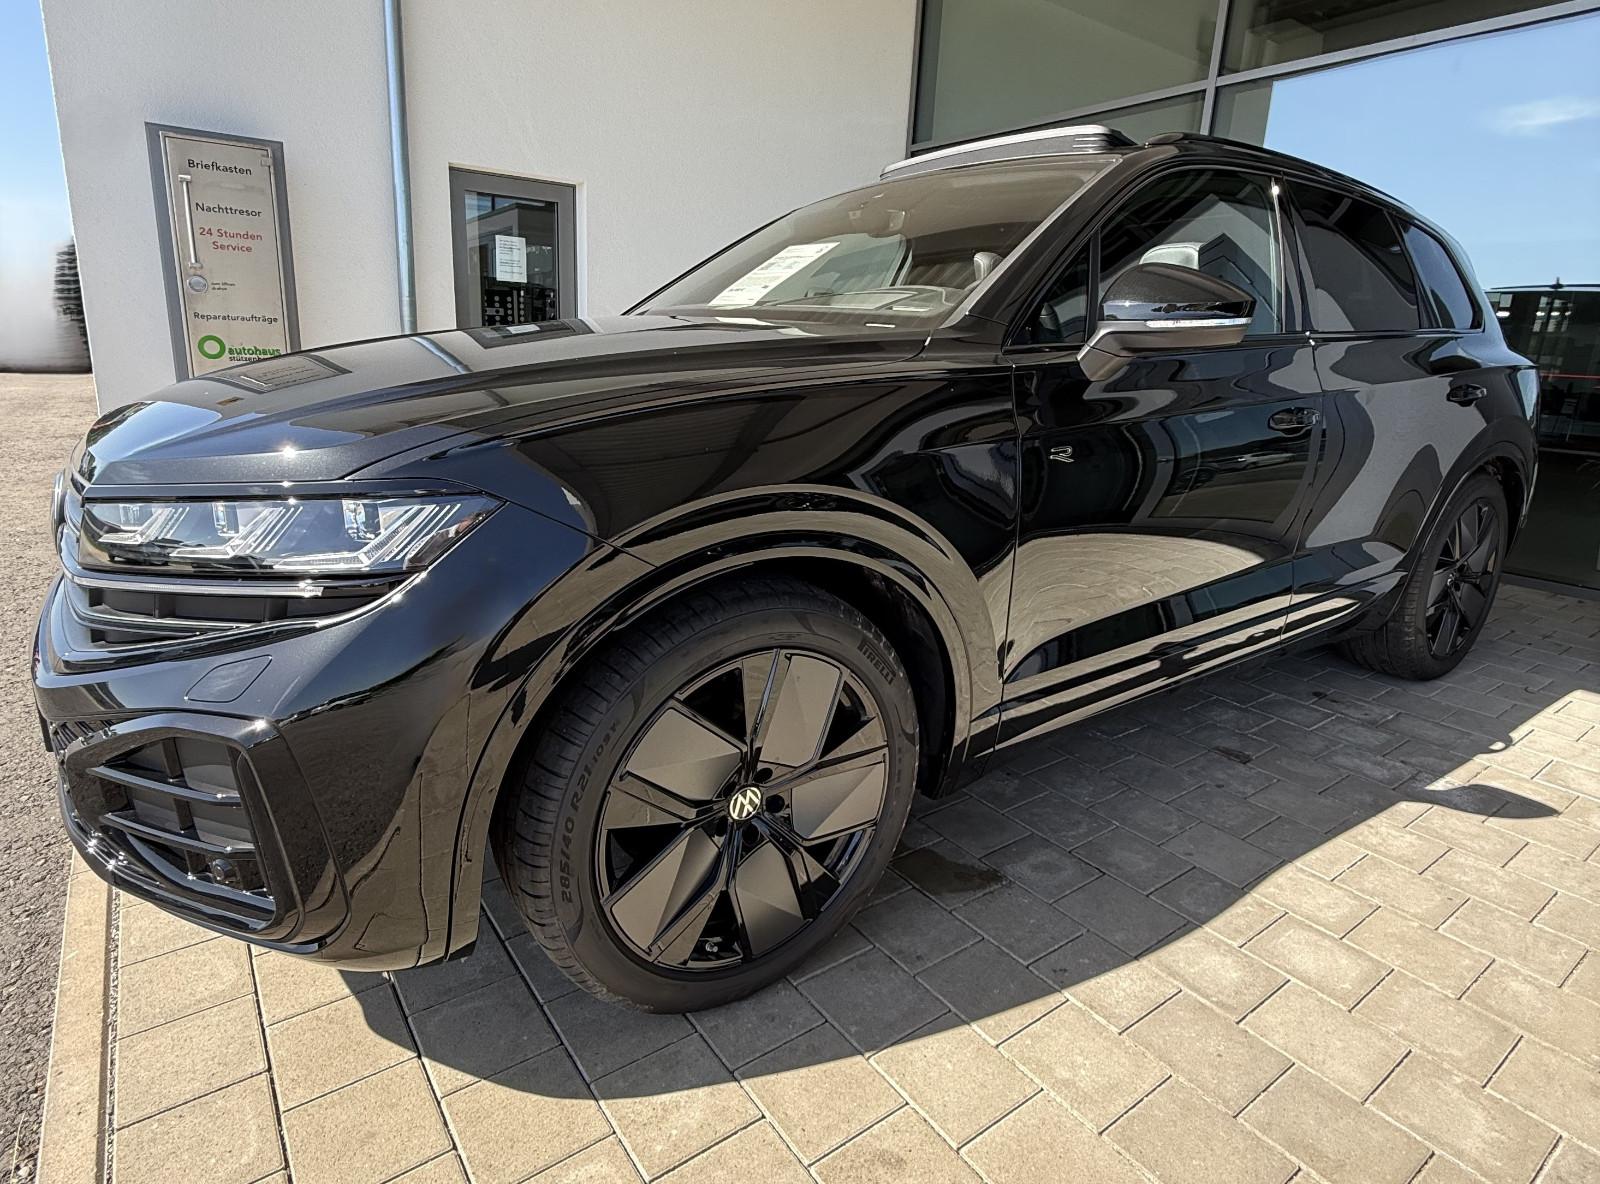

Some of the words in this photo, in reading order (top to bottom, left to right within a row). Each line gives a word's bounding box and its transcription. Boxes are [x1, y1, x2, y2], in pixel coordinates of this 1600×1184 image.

[187, 159, 252, 175] Briefkasten
[195, 202, 262, 217] Nachttresor
[199, 227, 213, 236] 24
[217, 229, 263, 240] Stunden
[212, 241, 253, 252] Service
[193, 312, 278, 324] Reparaturaufträge
[228, 347, 281, 356] autohaus
[857, 640, 896, 685] PIRELLI
[560, 817, 575, 903] 285/40
